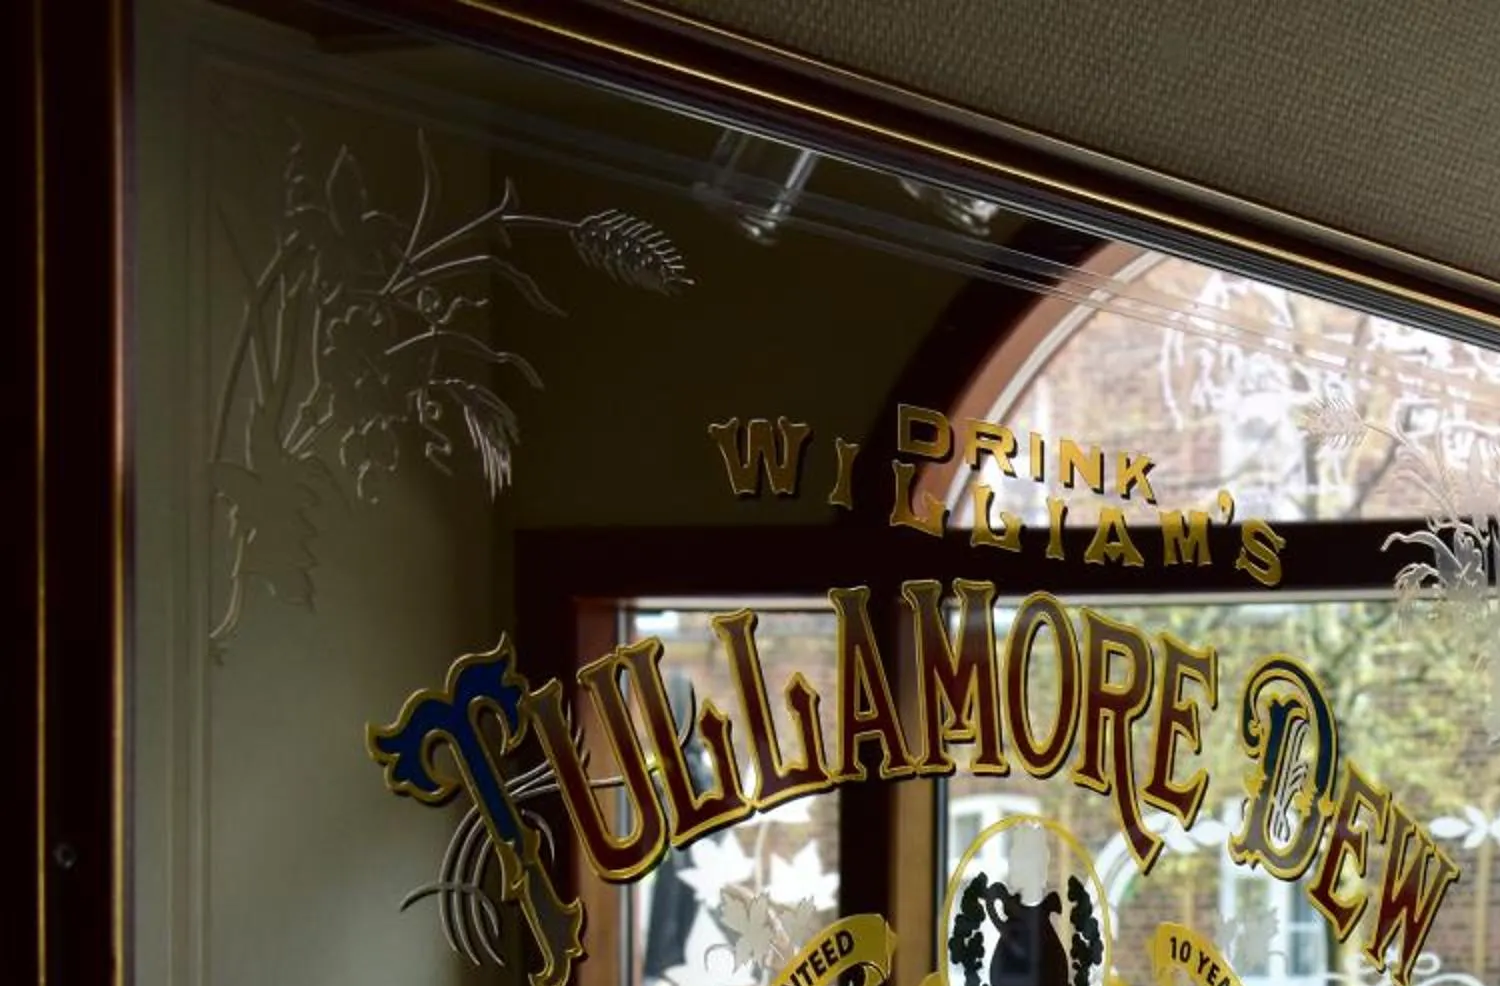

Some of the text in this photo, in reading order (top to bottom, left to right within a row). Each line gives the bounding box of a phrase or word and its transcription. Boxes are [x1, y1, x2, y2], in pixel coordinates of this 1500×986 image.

[707, 415, 1287, 588] WILLIAM'S
[898, 402, 1157, 503] DRINK
[1169, 936, 1192, 963] 10
